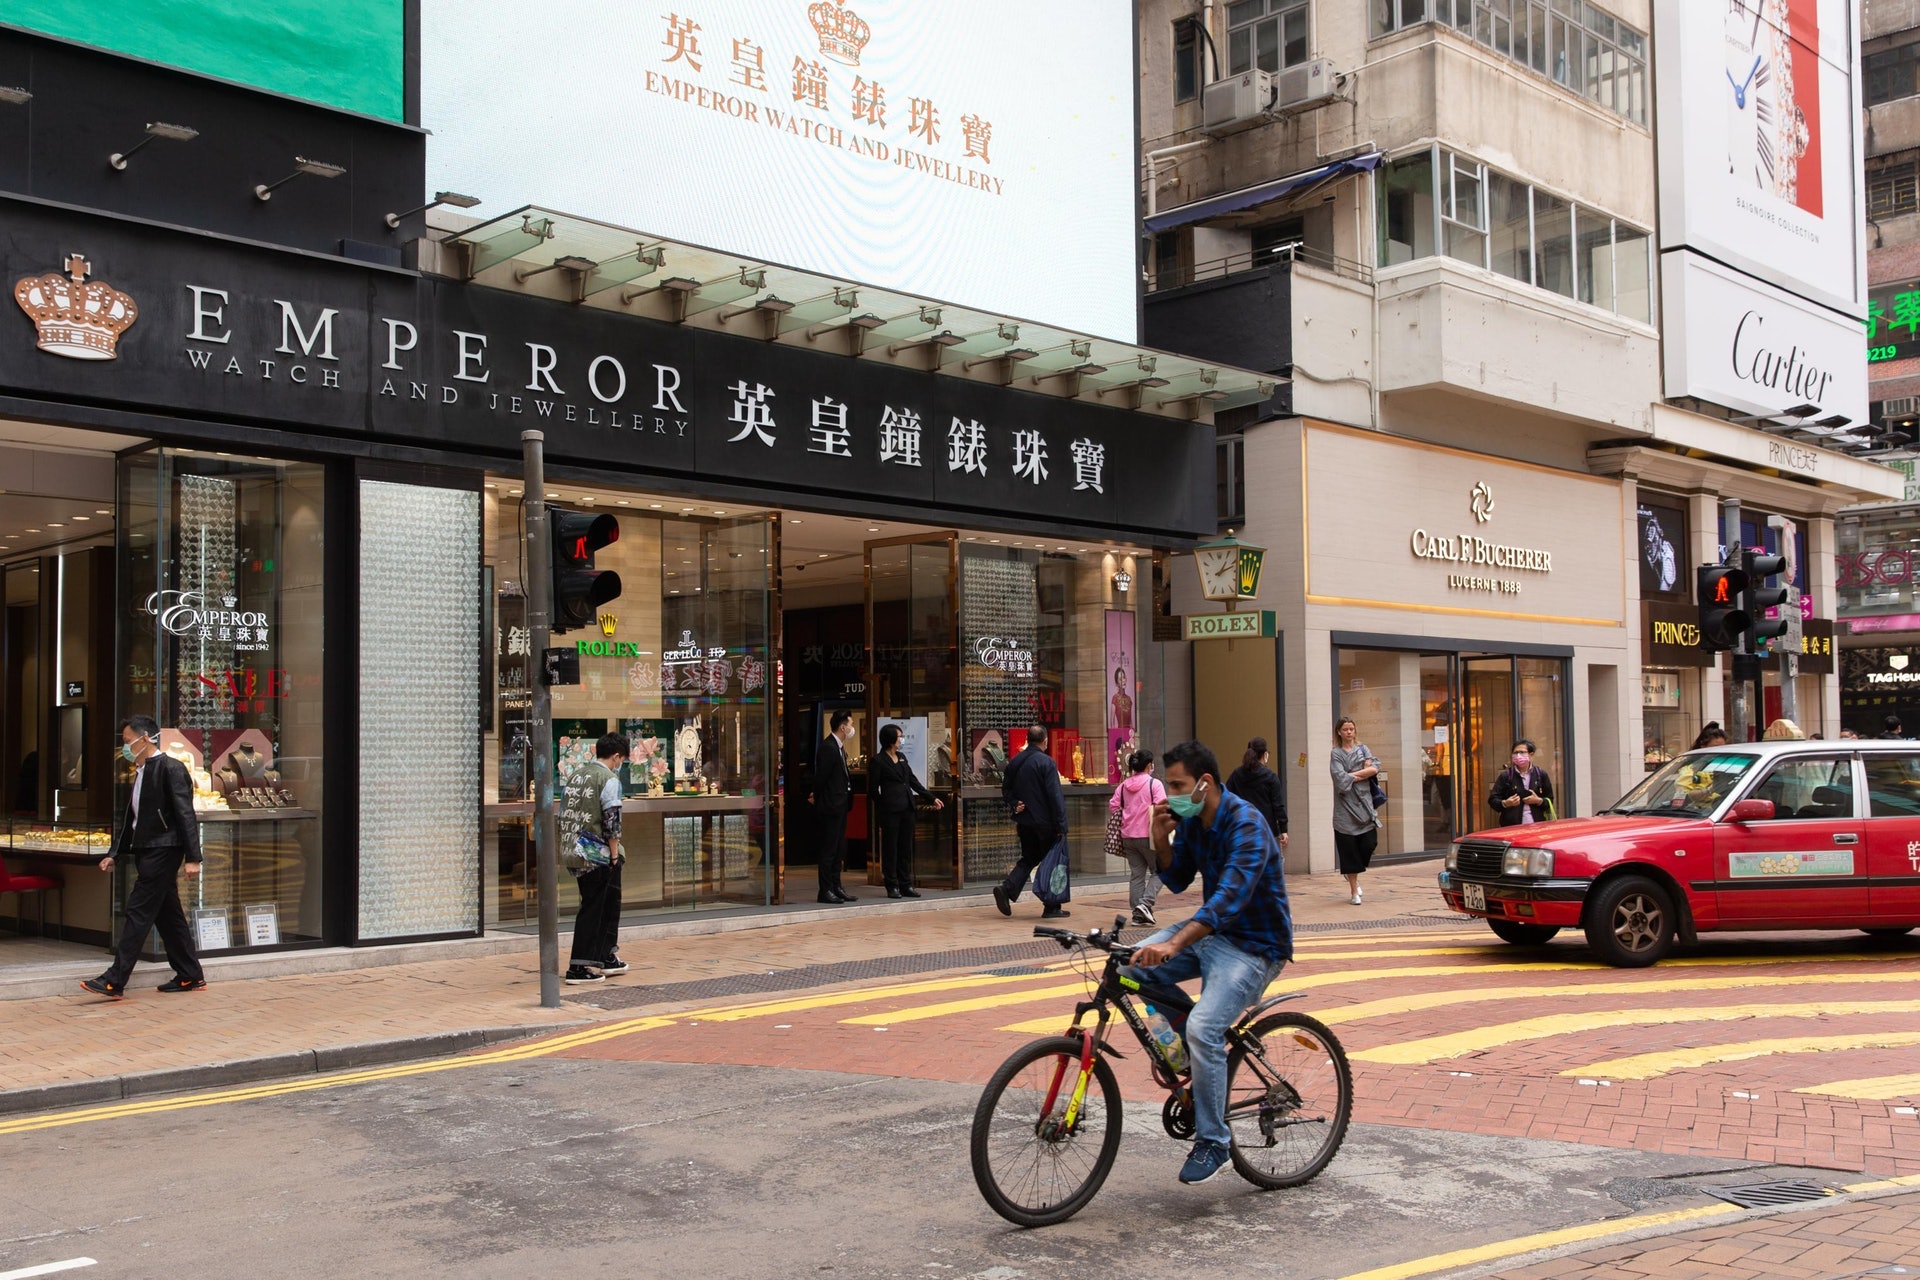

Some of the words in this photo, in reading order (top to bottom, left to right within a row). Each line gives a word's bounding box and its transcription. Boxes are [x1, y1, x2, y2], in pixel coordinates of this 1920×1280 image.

[661, 12, 992, 165] 英皇鐘錶珠寶
[645, 70, 760, 124] EMPEROR
[764, 106, 844, 149] WATCH
[848, 134, 890, 162] AND
[893, 147, 1005, 197] JEWELLERY
[1736, 197, 1775, 224] BAIGNOIRE
[1778, 217, 1819, 243] COLLECTION
[186, 284, 688, 414] EMPEROR
[1732, 310, 1833, 403] Cartier
[186, 348, 341, 389] WATCH
[380, 378, 459, 405] AND
[489, 393, 689, 437] JEWELLERY
[727, 380, 1107, 494] 英皇鐘錶珠寶
[1769, 441, 1802, 470] PRINCE
[1473, 536, 1553, 572] BUCHERER
[1449, 574, 1497, 592] LUCERNE
[1499, 580, 1522, 593] 1888
[198, 626, 269, 643] 英皇珠寶
[1190, 616, 1257, 634] ROLEX
[576, 639, 640, 657] ROLEX
[197, 668, 289, 698] SALE
[1867, 673, 1893, 684] TAG
[1027, 692, 1072, 712] SALE
[1769, 728, 1788, 738] TAXI
[1908, 856, 1920, 872] T
[1466, 895, 1484, 909] 7420
[1469, 884, 1478, 897] TP
